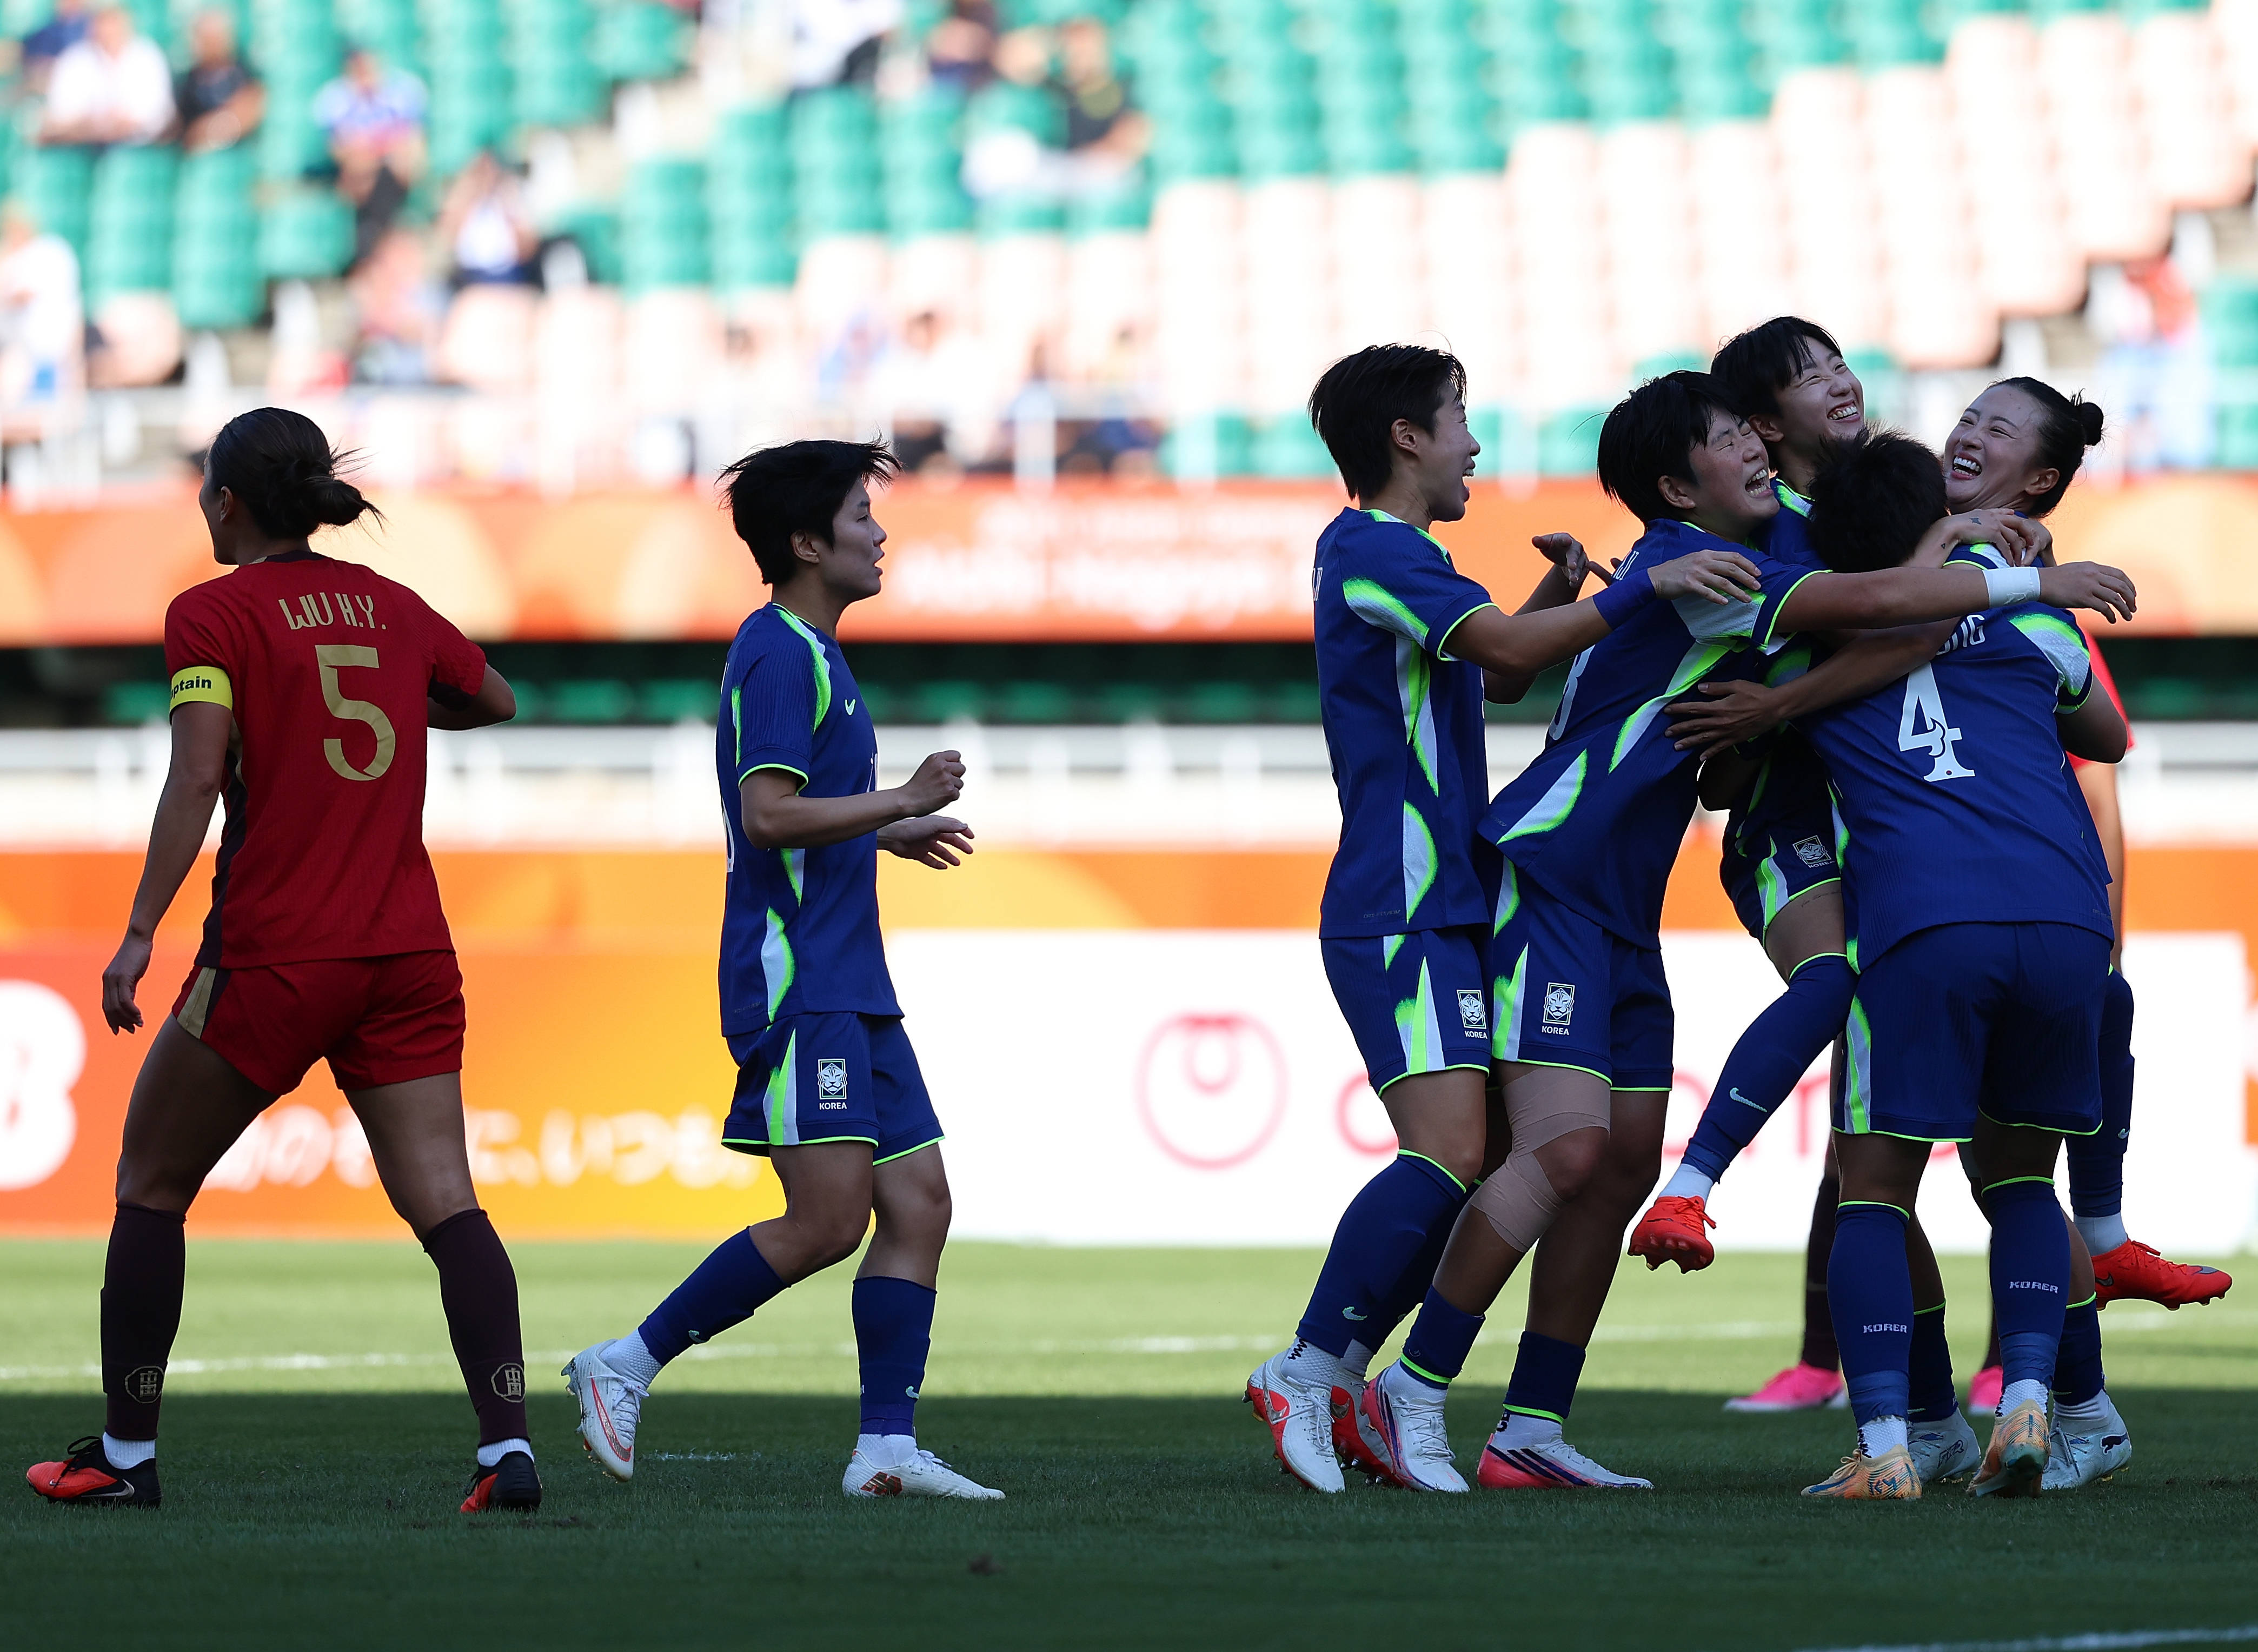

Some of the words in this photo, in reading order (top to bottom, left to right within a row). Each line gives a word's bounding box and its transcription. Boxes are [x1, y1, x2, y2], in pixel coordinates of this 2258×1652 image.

[278, 592, 334, 630] WU
[335, 593, 387, 629] H.Y.
[171, 676, 212, 699] ptain
[315, 644, 396, 781] 5
[1898, 661, 1975, 782] 4
[1808, 860, 1835, 868] KOREA
[1464, 1030, 1487, 1039] KOREA
[1542, 1026, 1570, 1036] KOREA
[819, 1102, 847, 1110] KOREA
